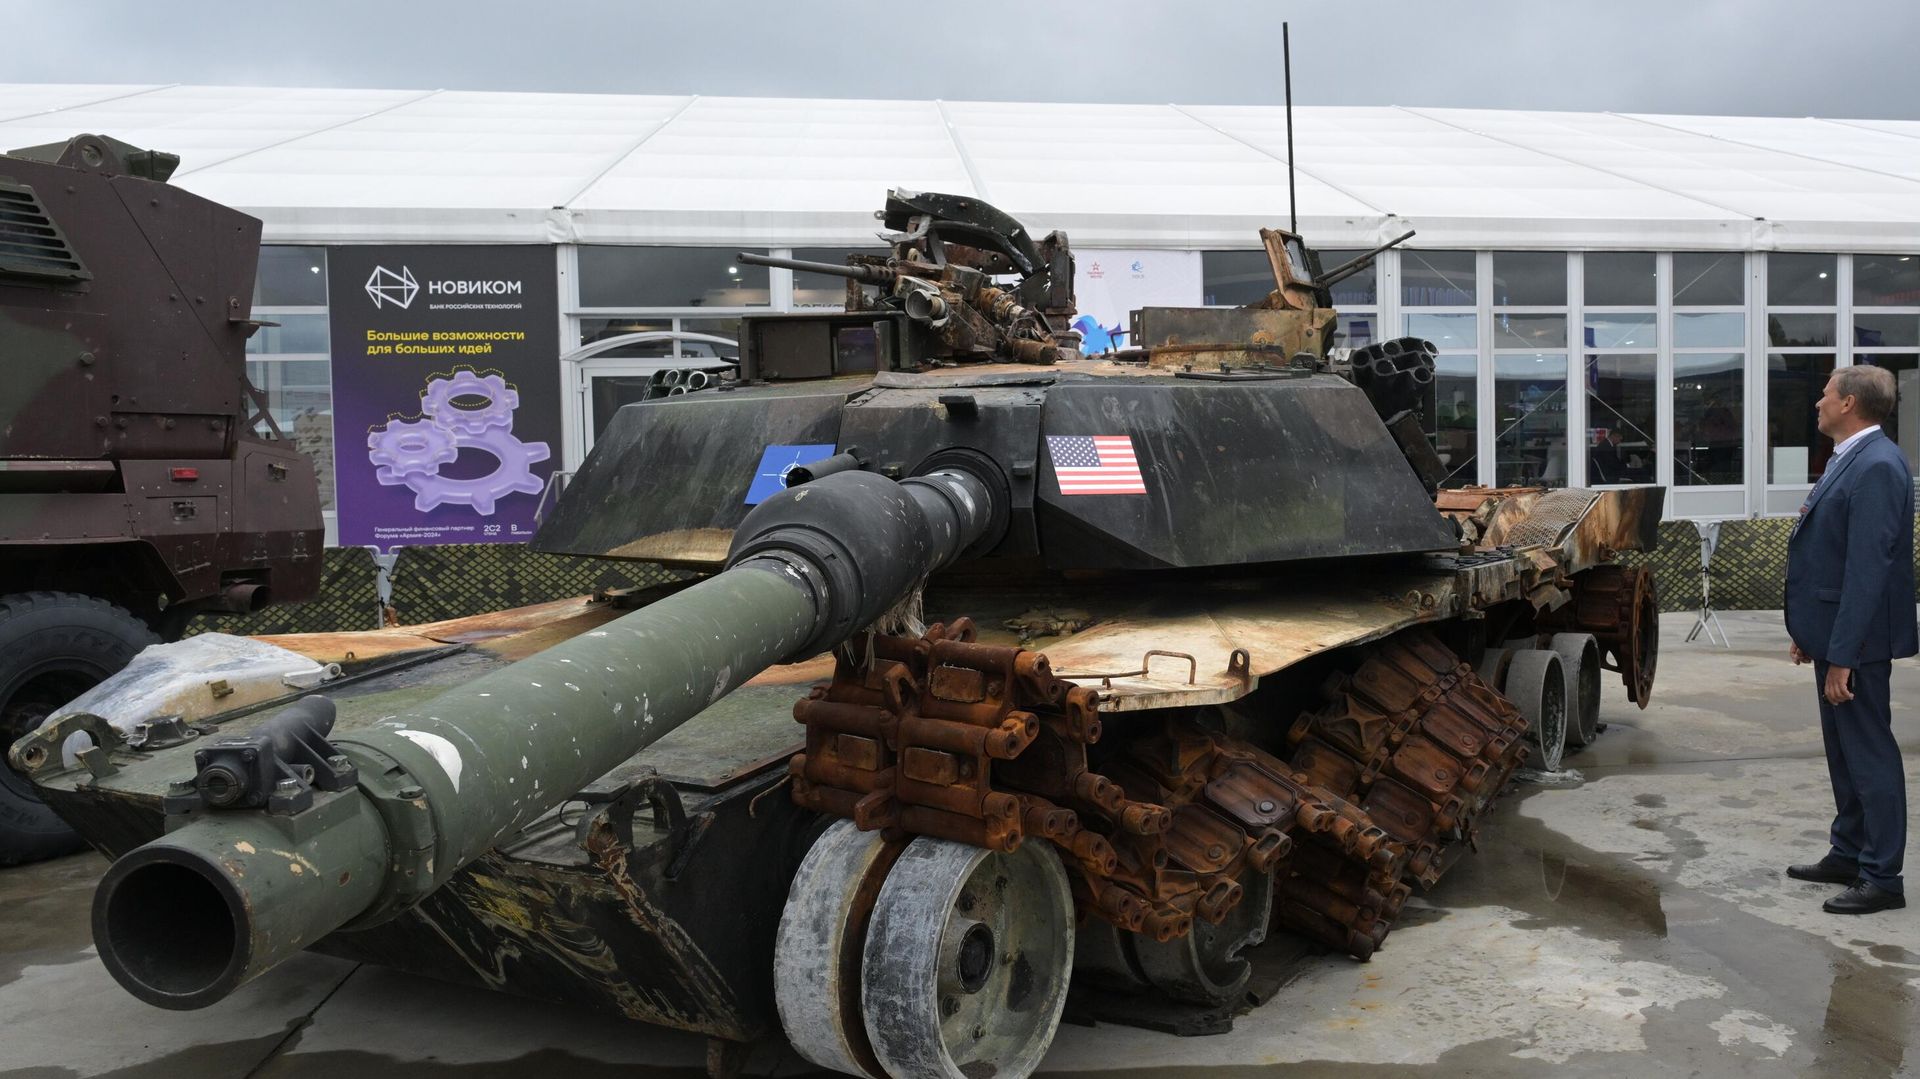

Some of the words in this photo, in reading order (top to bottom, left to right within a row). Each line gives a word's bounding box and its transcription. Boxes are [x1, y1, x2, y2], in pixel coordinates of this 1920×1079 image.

[429, 281, 522, 294] НОВИКОМ
[367, 330, 429, 341] Большие
[432, 331, 525, 341] возможности
[367, 345, 392, 355] для
[395, 343, 455, 354] больших
[458, 342, 492, 354] идей
